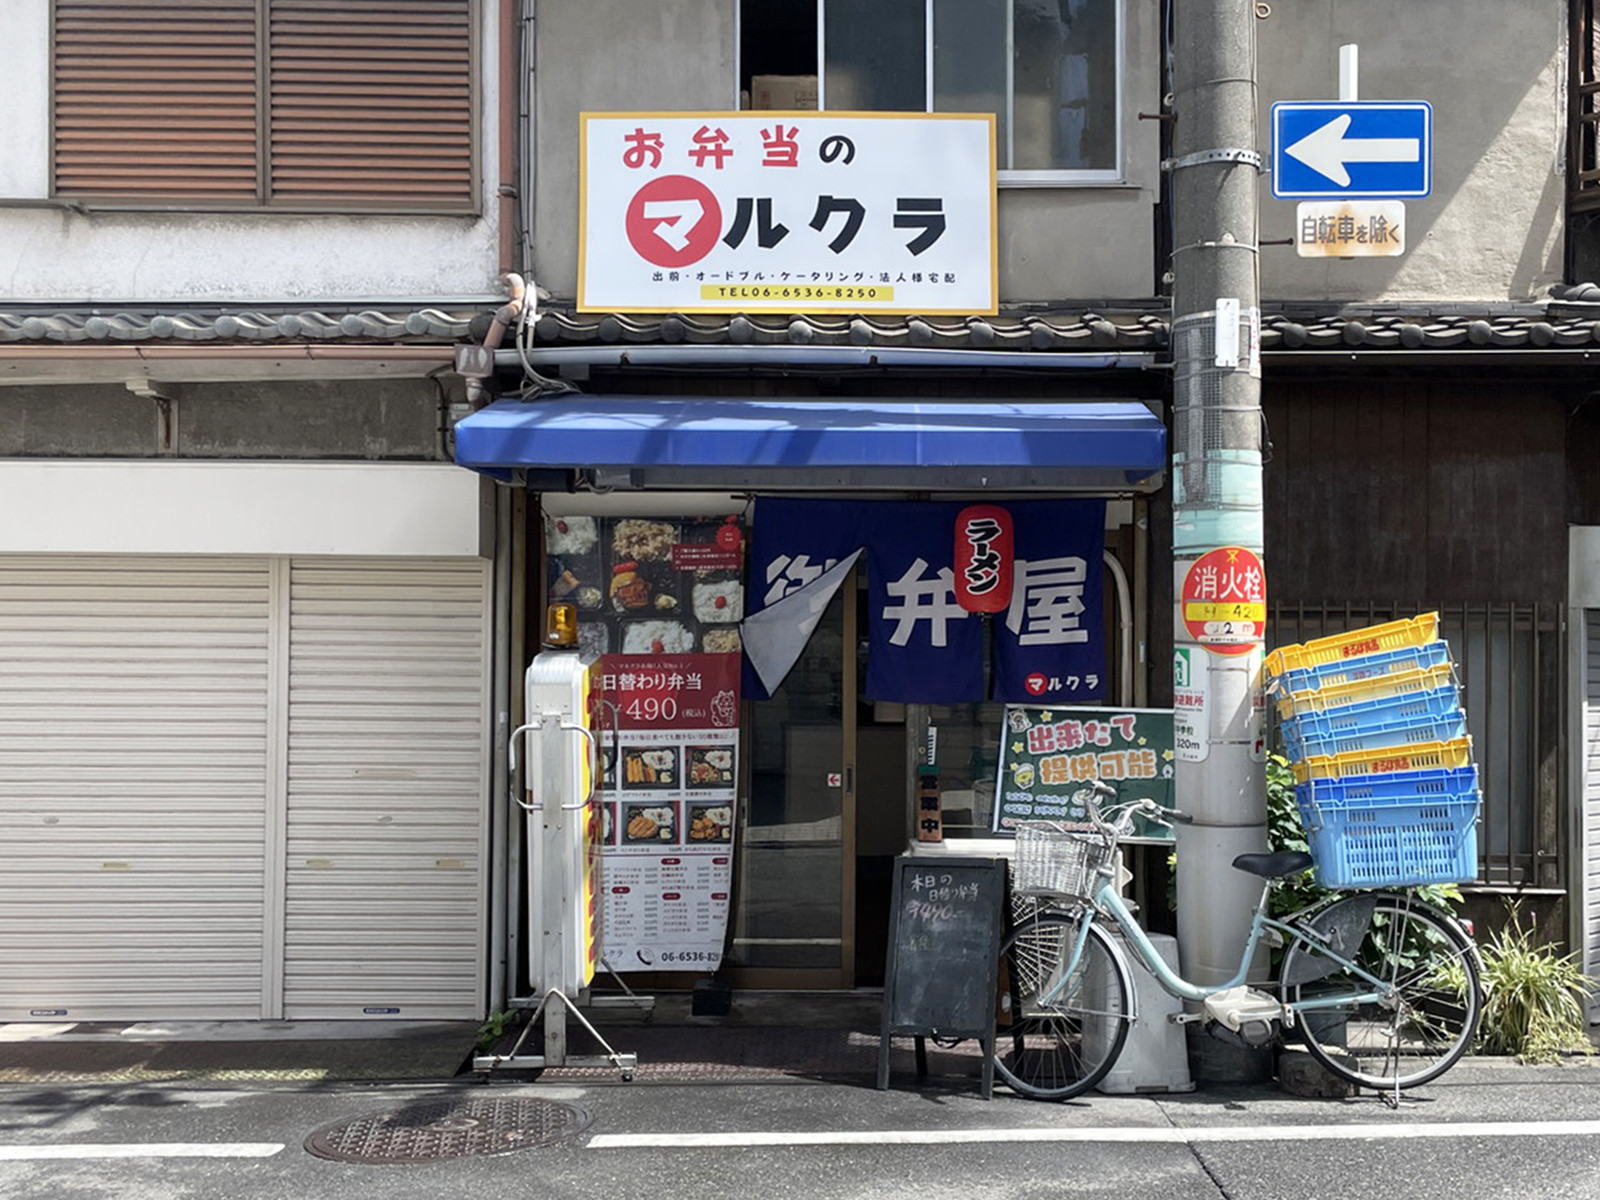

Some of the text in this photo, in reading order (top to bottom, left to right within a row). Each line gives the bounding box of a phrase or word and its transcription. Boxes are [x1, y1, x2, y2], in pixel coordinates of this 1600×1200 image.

[622, 125, 856, 169] お弁当の
[642, 195, 946, 257] マルクラ
[1301, 214, 1401, 245] 自転車を除く
[965, 518, 1001, 595] ラーメン
[1193, 565, 1262, 599] 消火栓
[602, 673, 702, 692] 日替わり弁当
[1027, 673, 1099, 692] マルクラ
[1027, 715, 1136, 754] 出来たて
[1040, 749, 1158, 785] 提供可能
[911, 873, 953, 893] 本日の
